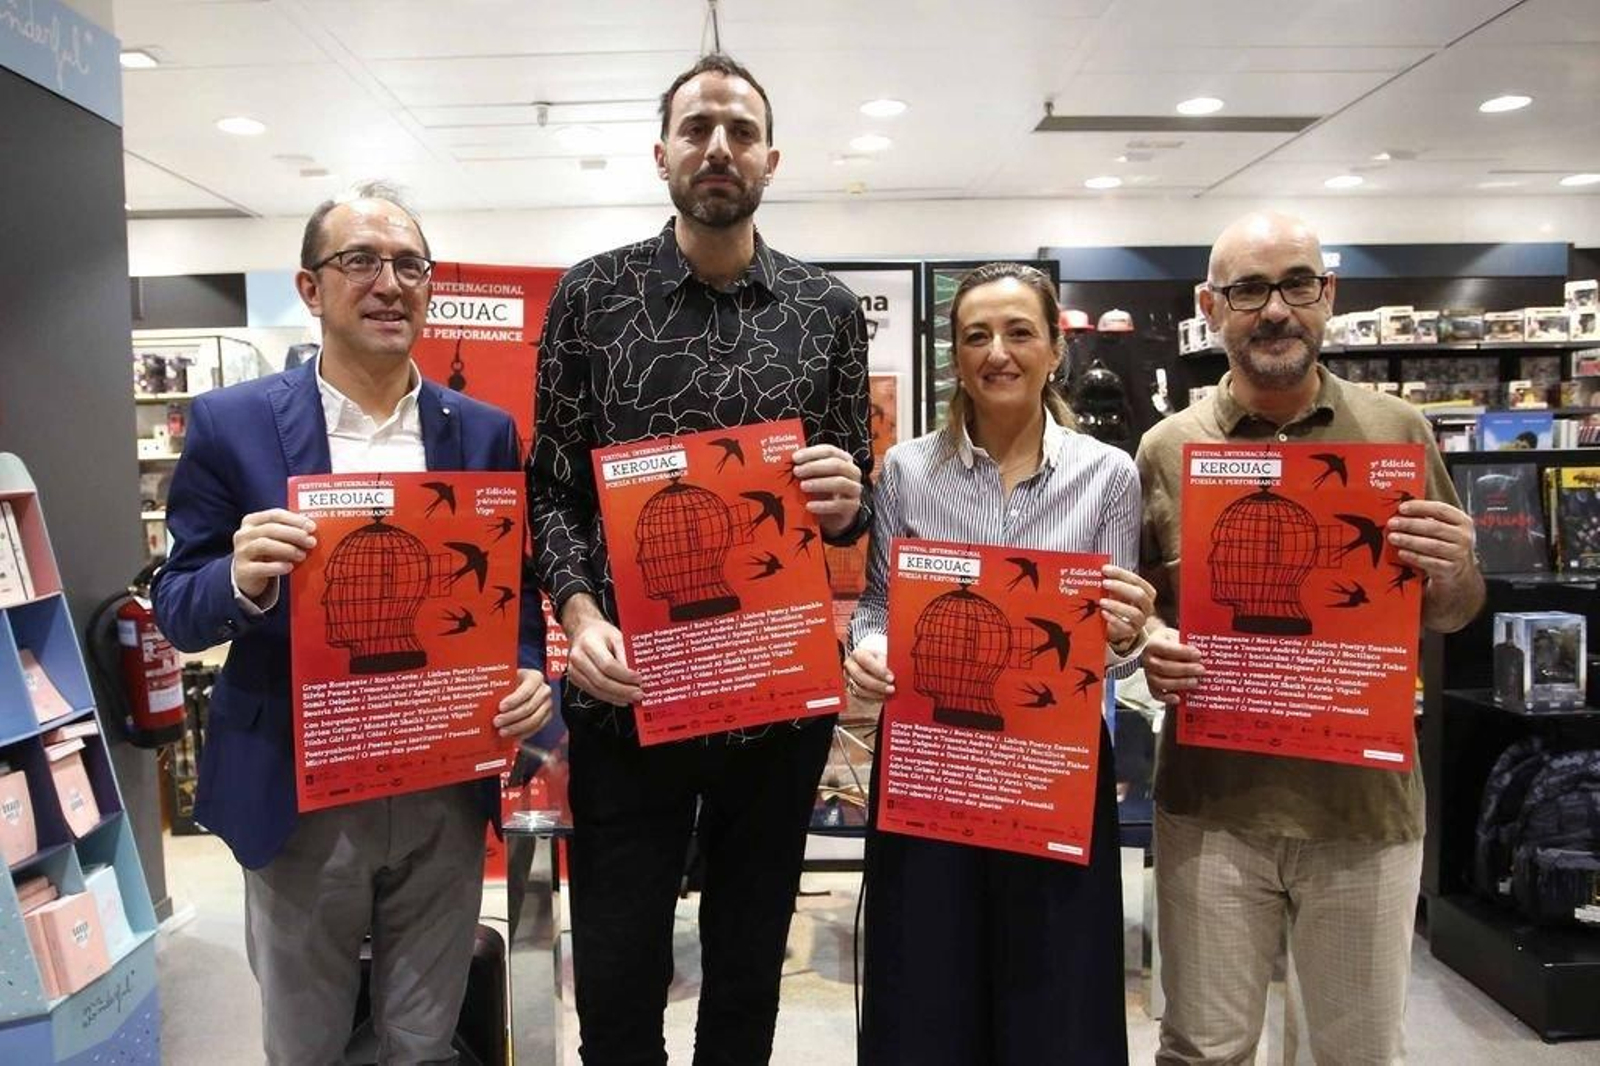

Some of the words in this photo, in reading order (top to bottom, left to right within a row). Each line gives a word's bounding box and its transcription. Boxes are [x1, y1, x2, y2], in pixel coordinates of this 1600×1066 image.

[431, 282, 524, 295] INTERNACIONAL
[434, 329, 523, 341] PERFORMANCE
[611, 455, 677, 475] KEROUAC
[1200, 462, 1270, 473] KEROUAC
[1369, 479, 1391, 489] Vigo
[309, 492, 383, 504] KEROUAC
[476, 507, 494, 516] Vigo
[907, 556, 971, 572] KEROUAC
[1340, 643, 1365, 652] Poetry
